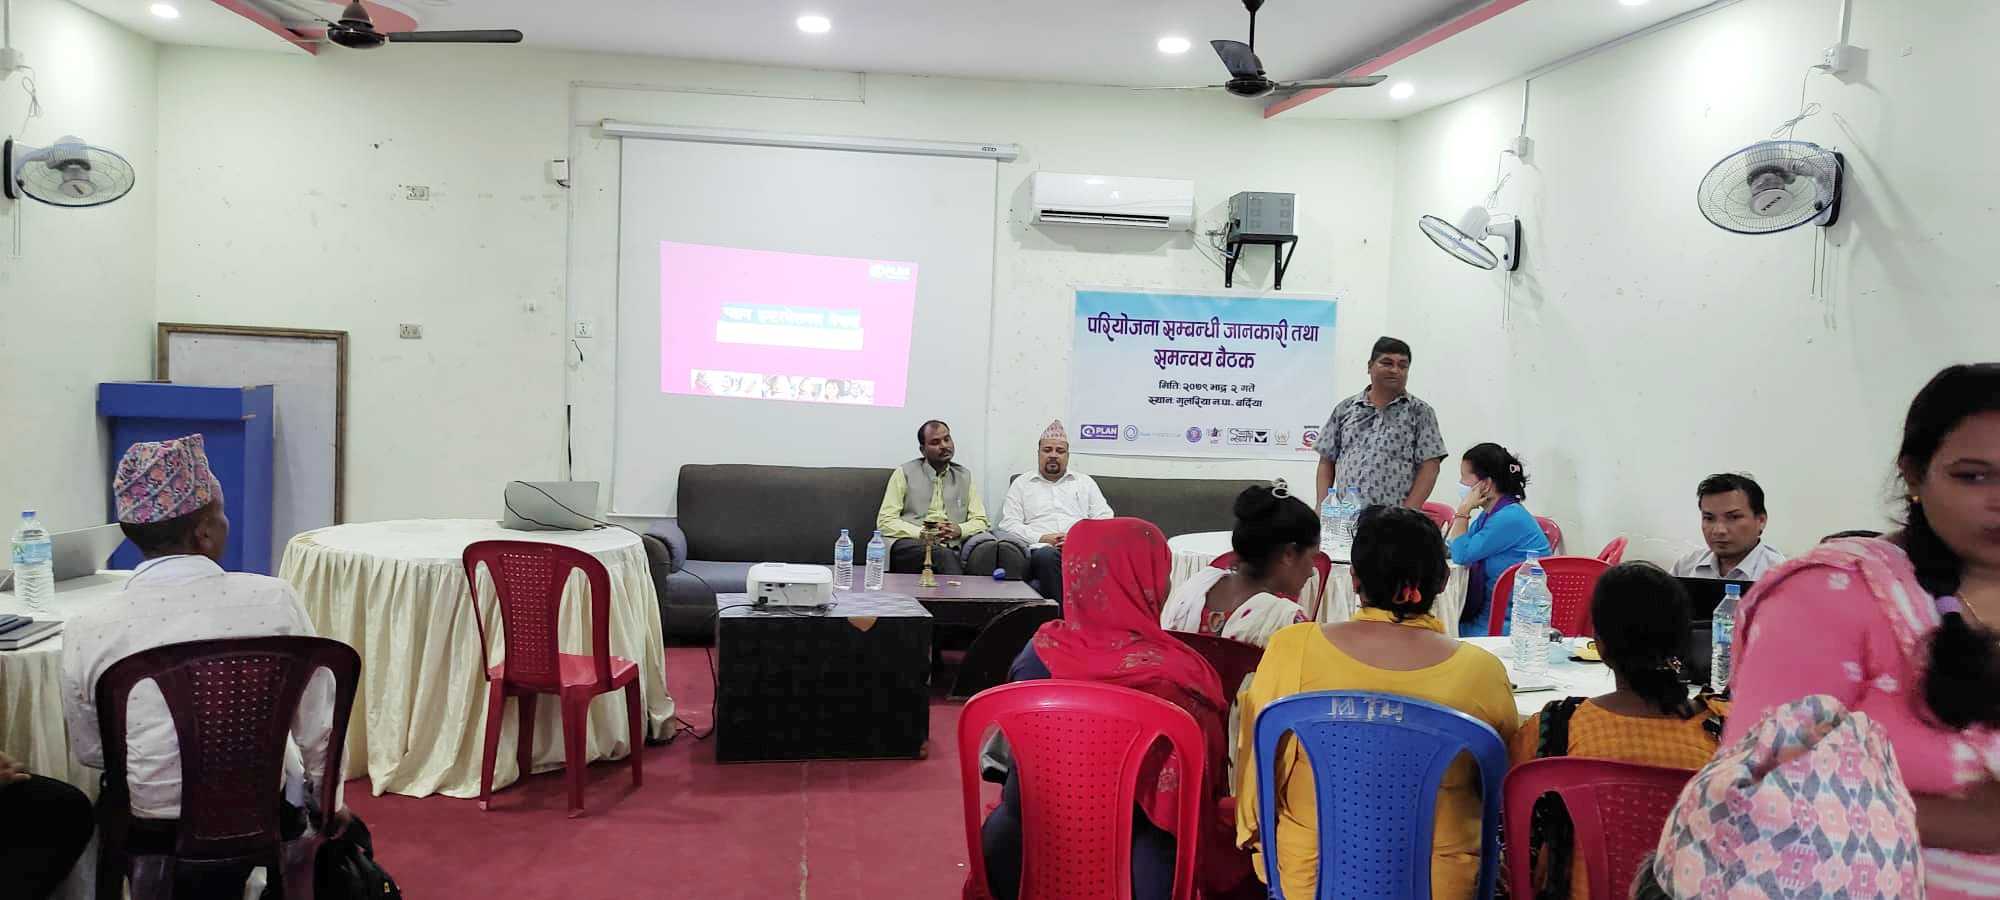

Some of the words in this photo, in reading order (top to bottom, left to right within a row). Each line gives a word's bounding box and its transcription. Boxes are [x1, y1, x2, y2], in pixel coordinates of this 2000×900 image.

[1087, 312, 1160, 341] परियोजना
[1163, 316, 1220, 341] सम्बन्धी
[1223, 319, 1288, 348] जानकारी
[1291, 325, 1319, 342] तथा
[1154, 349, 1213, 370] समन्वय
[1216, 345, 1256, 369] बैठक
[1230, 384, 1238, 393] २
